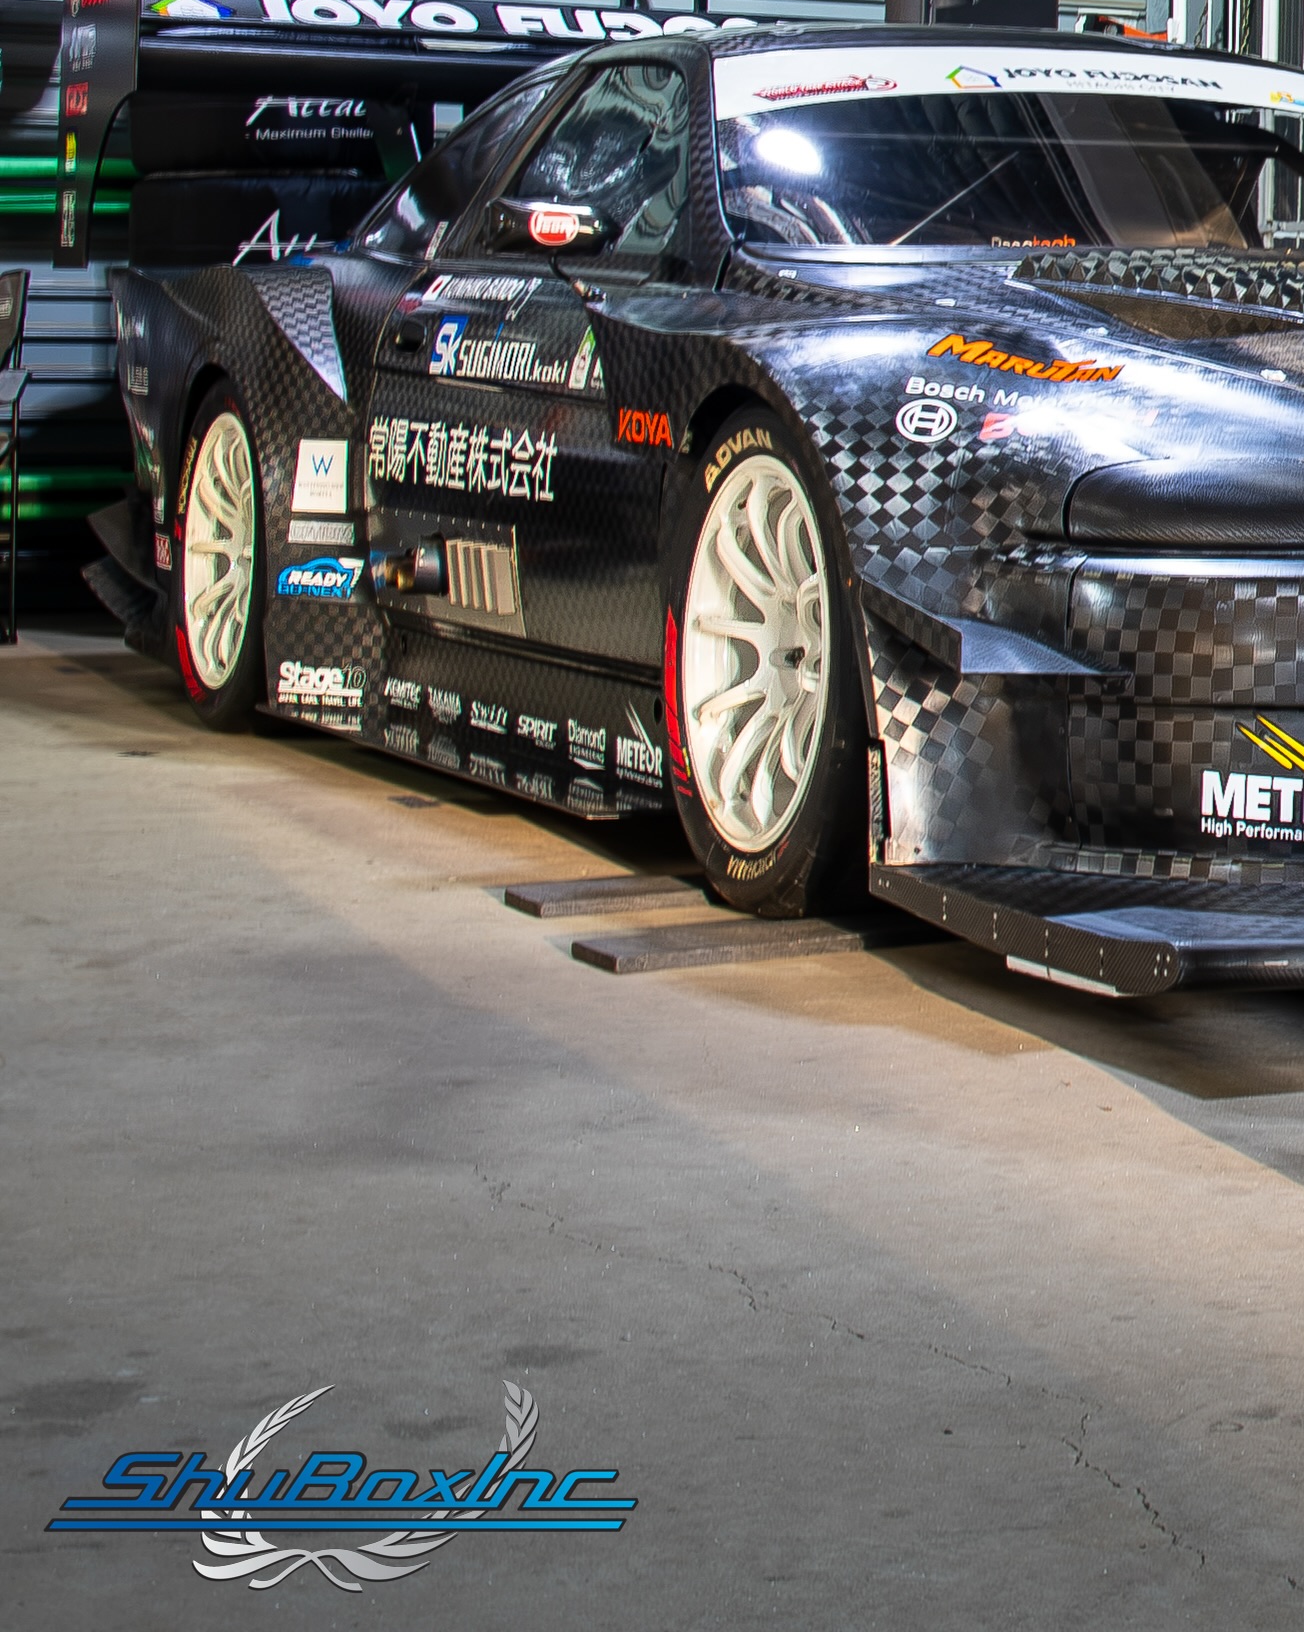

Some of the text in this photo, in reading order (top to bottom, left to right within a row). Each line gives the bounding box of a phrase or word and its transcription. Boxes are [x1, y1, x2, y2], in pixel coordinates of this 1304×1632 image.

[255, 128, 327, 141] Maximum
[904, 375, 986, 404] Bosch
[617, 407, 674, 449] KOYA
[368, 415, 558, 503] 常陽不動産株式会社
[704, 426, 774, 494] ADVAN
[287, 570, 348, 588] READY
[517, 714, 558, 743] SPIRIT
[616, 734, 663, 778] METEOR
[1201, 817, 1233, 838] High
